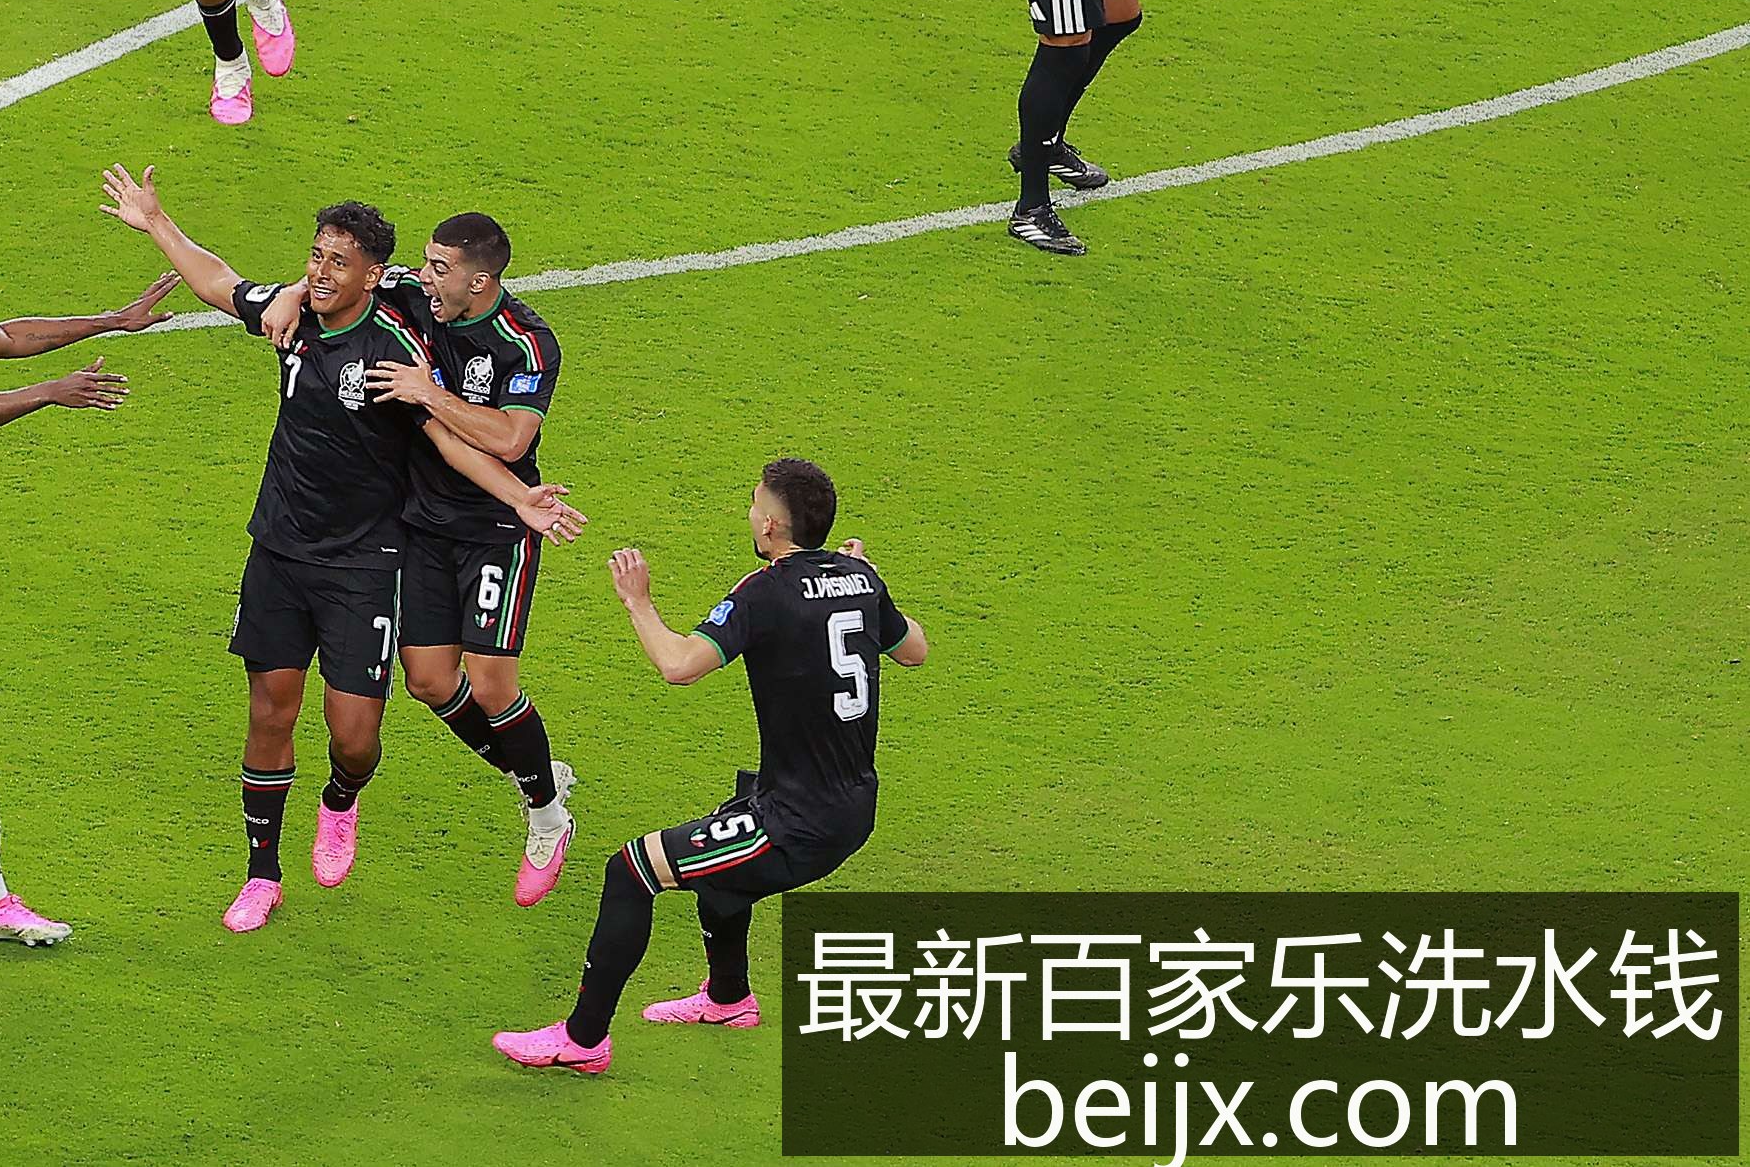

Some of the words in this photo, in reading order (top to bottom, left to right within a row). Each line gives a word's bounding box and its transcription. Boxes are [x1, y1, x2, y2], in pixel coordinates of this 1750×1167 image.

[284, 353, 302, 399] 7
[477, 564, 504, 611] 6
[373, 616, 392, 662] 7
[827, 610, 869, 721] 5
[709, 814, 756, 841] 5
